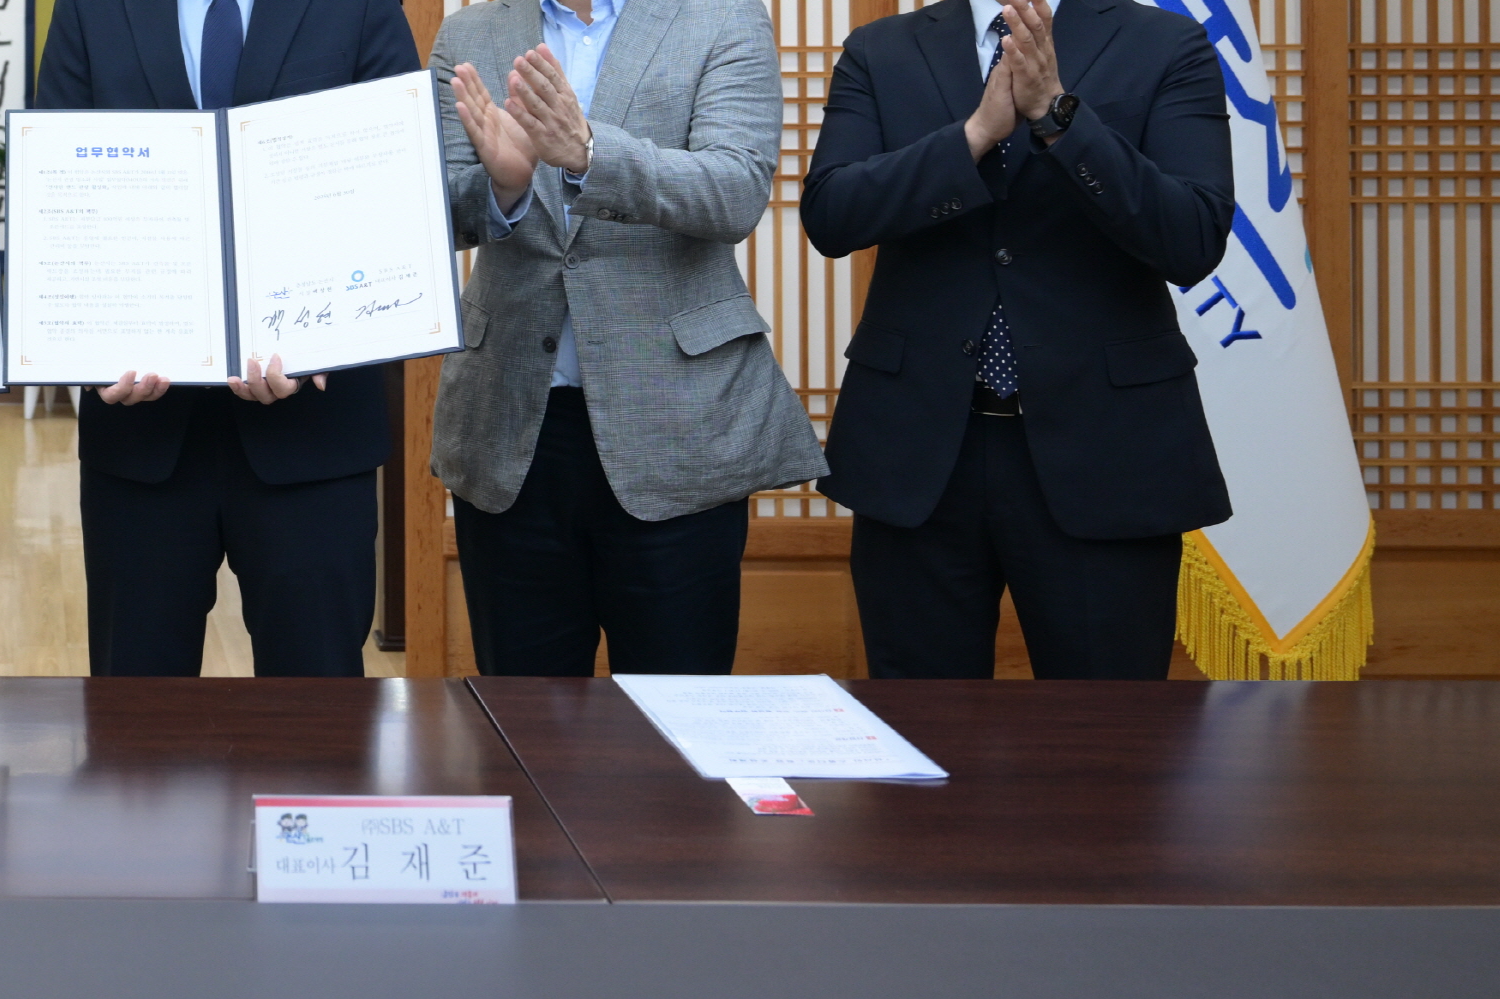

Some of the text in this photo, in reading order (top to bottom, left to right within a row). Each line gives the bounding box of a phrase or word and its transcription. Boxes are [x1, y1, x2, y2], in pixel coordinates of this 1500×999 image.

[75, 146, 151, 159] 업무협약서
[423, 817, 465, 836] A&T
[276, 856, 336, 875] 대표이사
